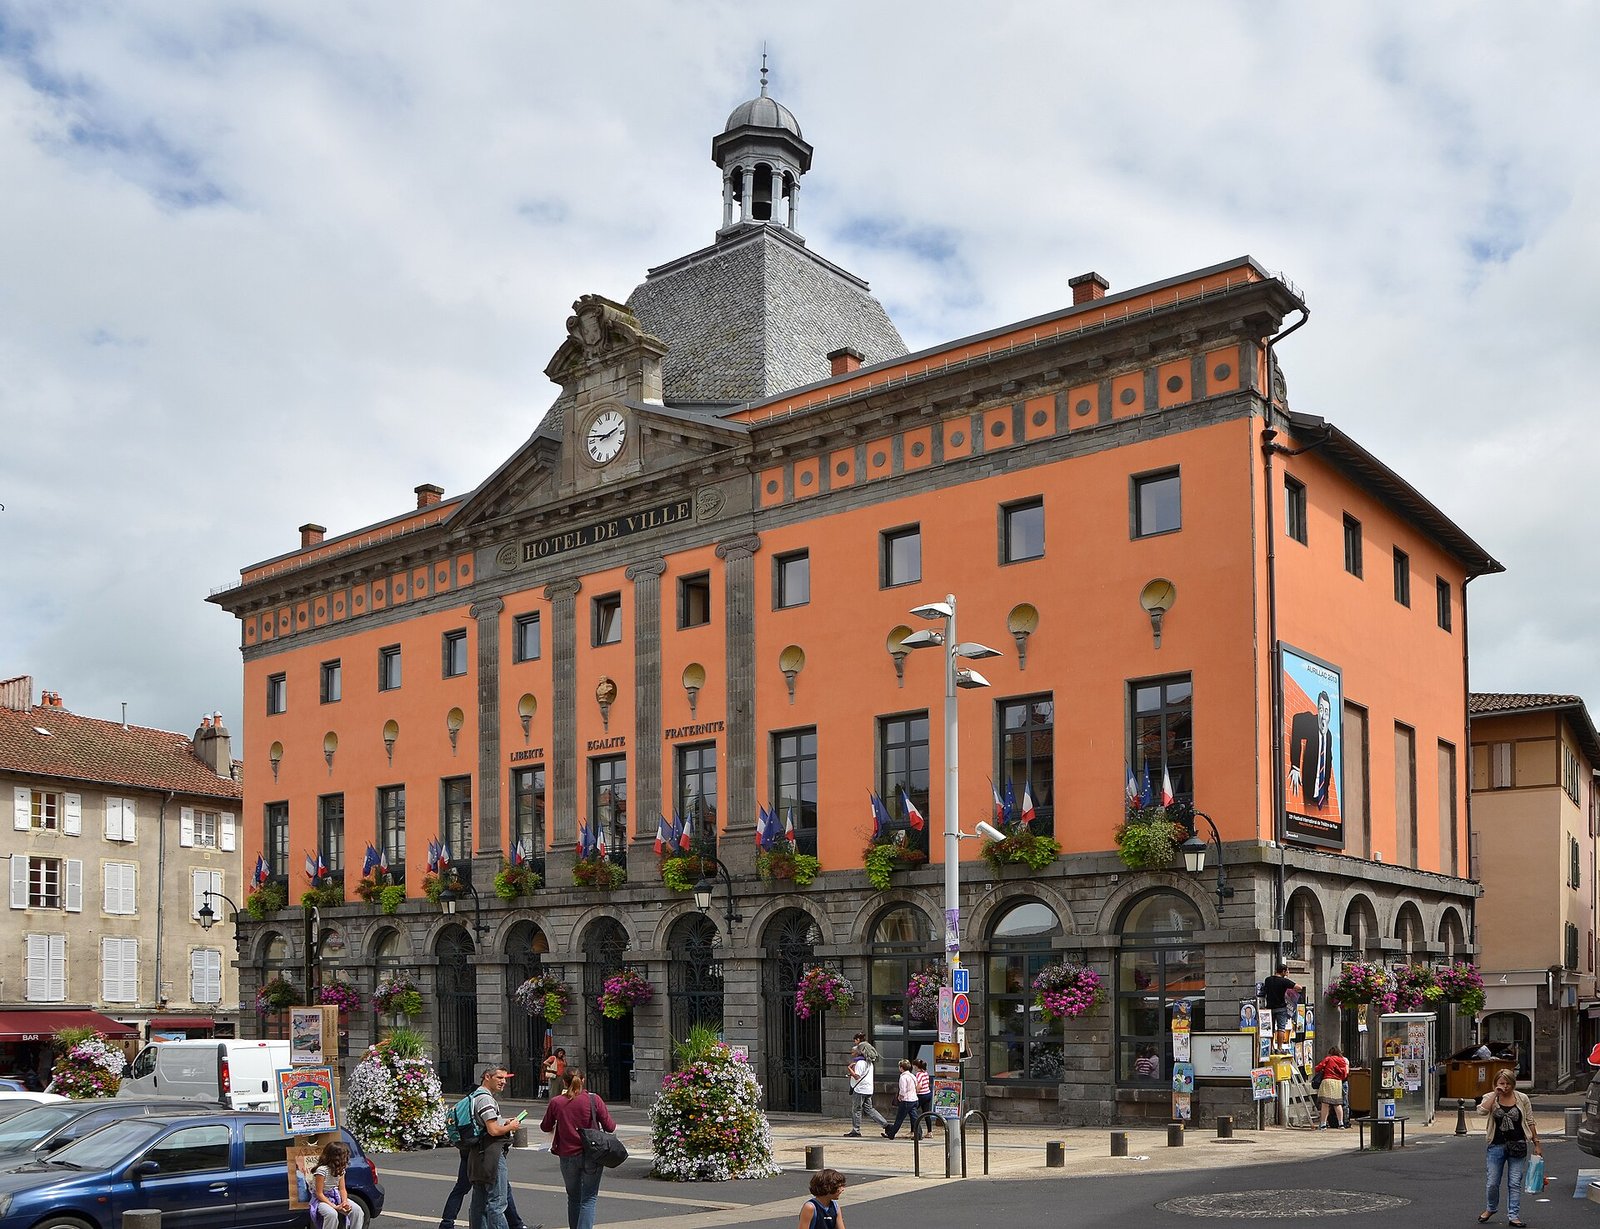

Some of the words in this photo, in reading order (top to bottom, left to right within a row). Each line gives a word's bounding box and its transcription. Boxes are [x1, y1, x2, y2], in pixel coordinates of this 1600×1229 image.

[594, 521, 619, 542] DE
[626, 501, 689, 531] VILLE
[1306, 665, 1328, 679] AURILLAC
[587, 736, 626, 752] EGALITE
[510, 747, 544, 762] LIBERTE
